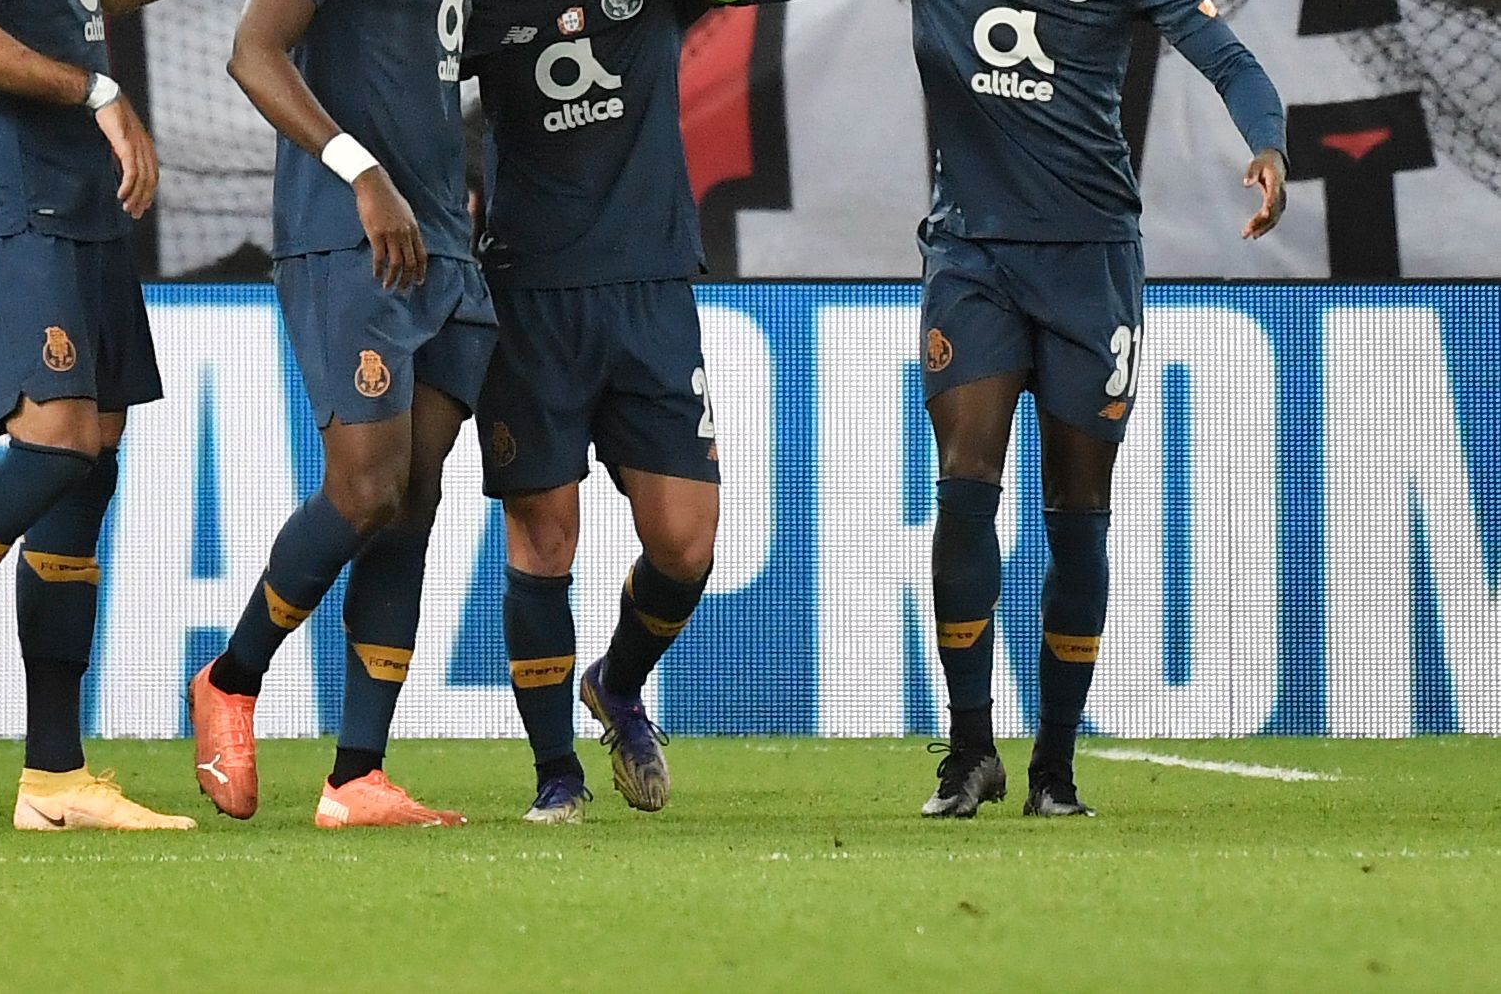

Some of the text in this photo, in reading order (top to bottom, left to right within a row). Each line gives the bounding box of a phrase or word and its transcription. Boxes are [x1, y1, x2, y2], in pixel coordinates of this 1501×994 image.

[971, 69, 1054, 102] altice
[543, 97, 624, 133] altice
[1105, 325, 1141, 397] 31
